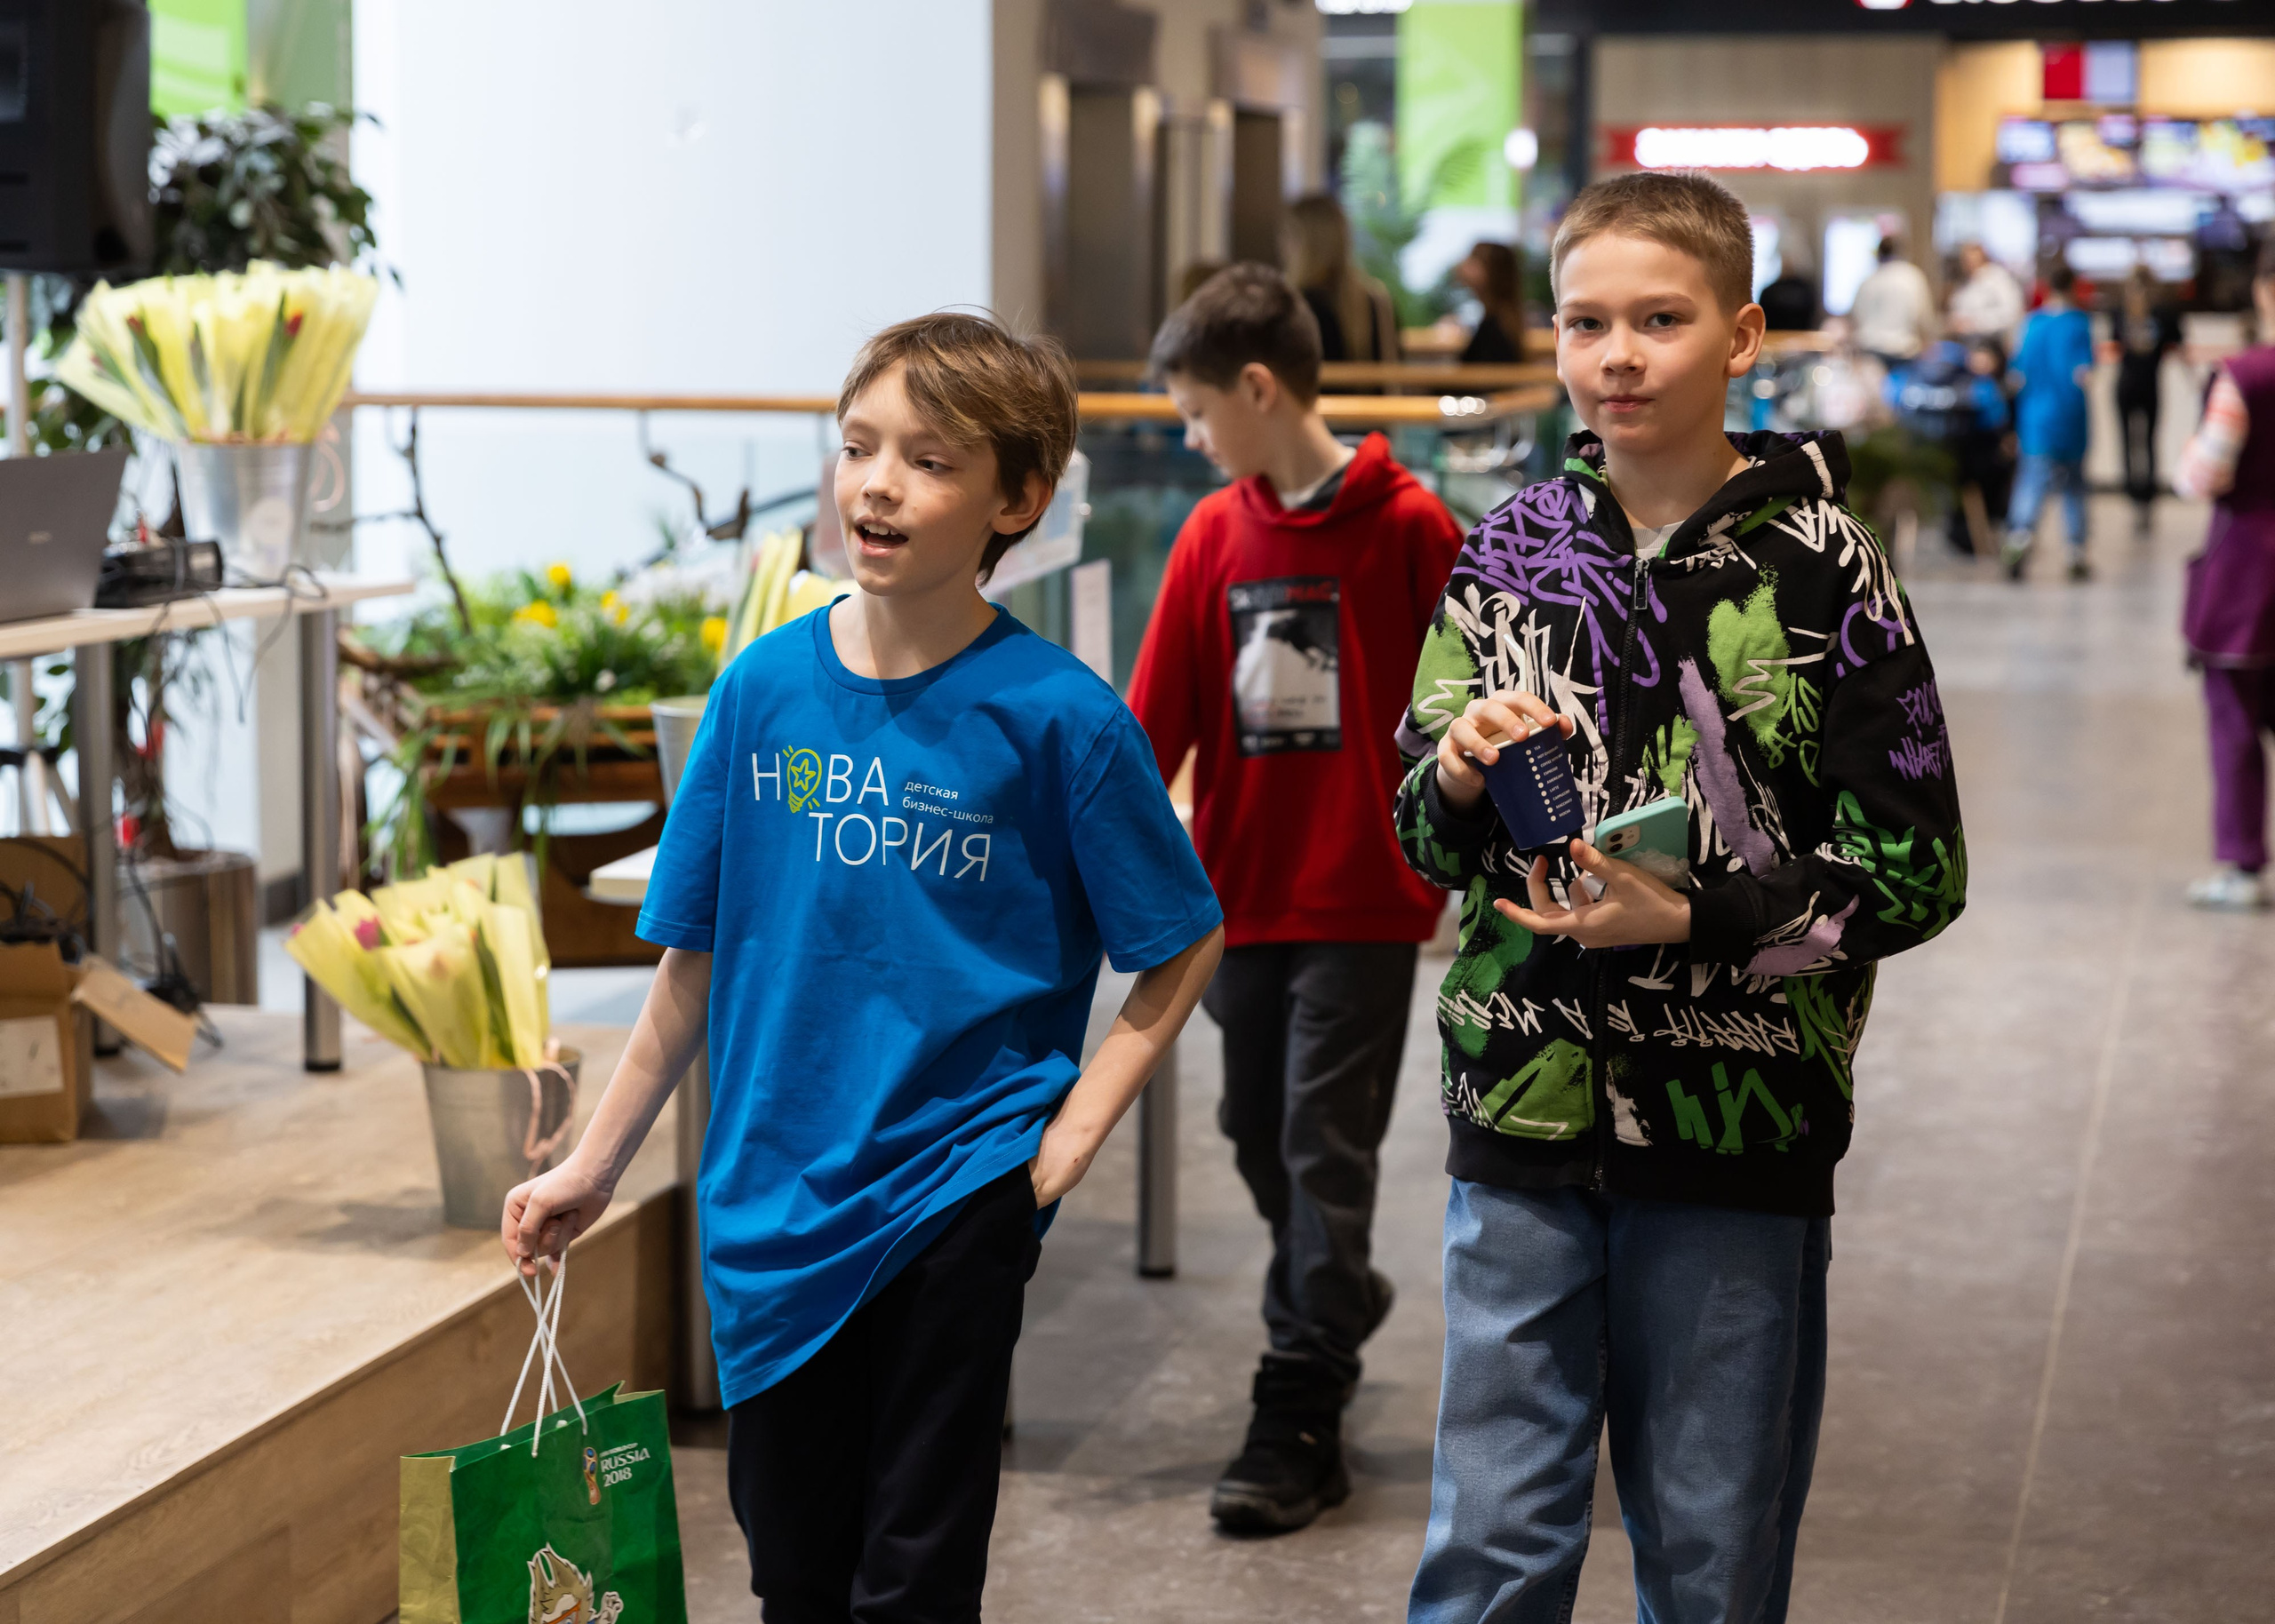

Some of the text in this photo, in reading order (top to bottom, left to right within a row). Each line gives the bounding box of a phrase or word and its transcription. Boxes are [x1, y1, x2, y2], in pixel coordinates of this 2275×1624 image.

[1544, 766, 1558, 776] ESPRESSO
[1547, 773, 1564, 784] AMERICANO
[905, 780, 959, 800] детская
[902, 796, 994, 824] бизнес-школа
[1559, 808, 1571, 817] MOCHA
[808, 812, 991, 882] ТОРИЯ
[600, 1447, 651, 1473] RUSSIA
[603, 1467, 633, 1487] 2018
